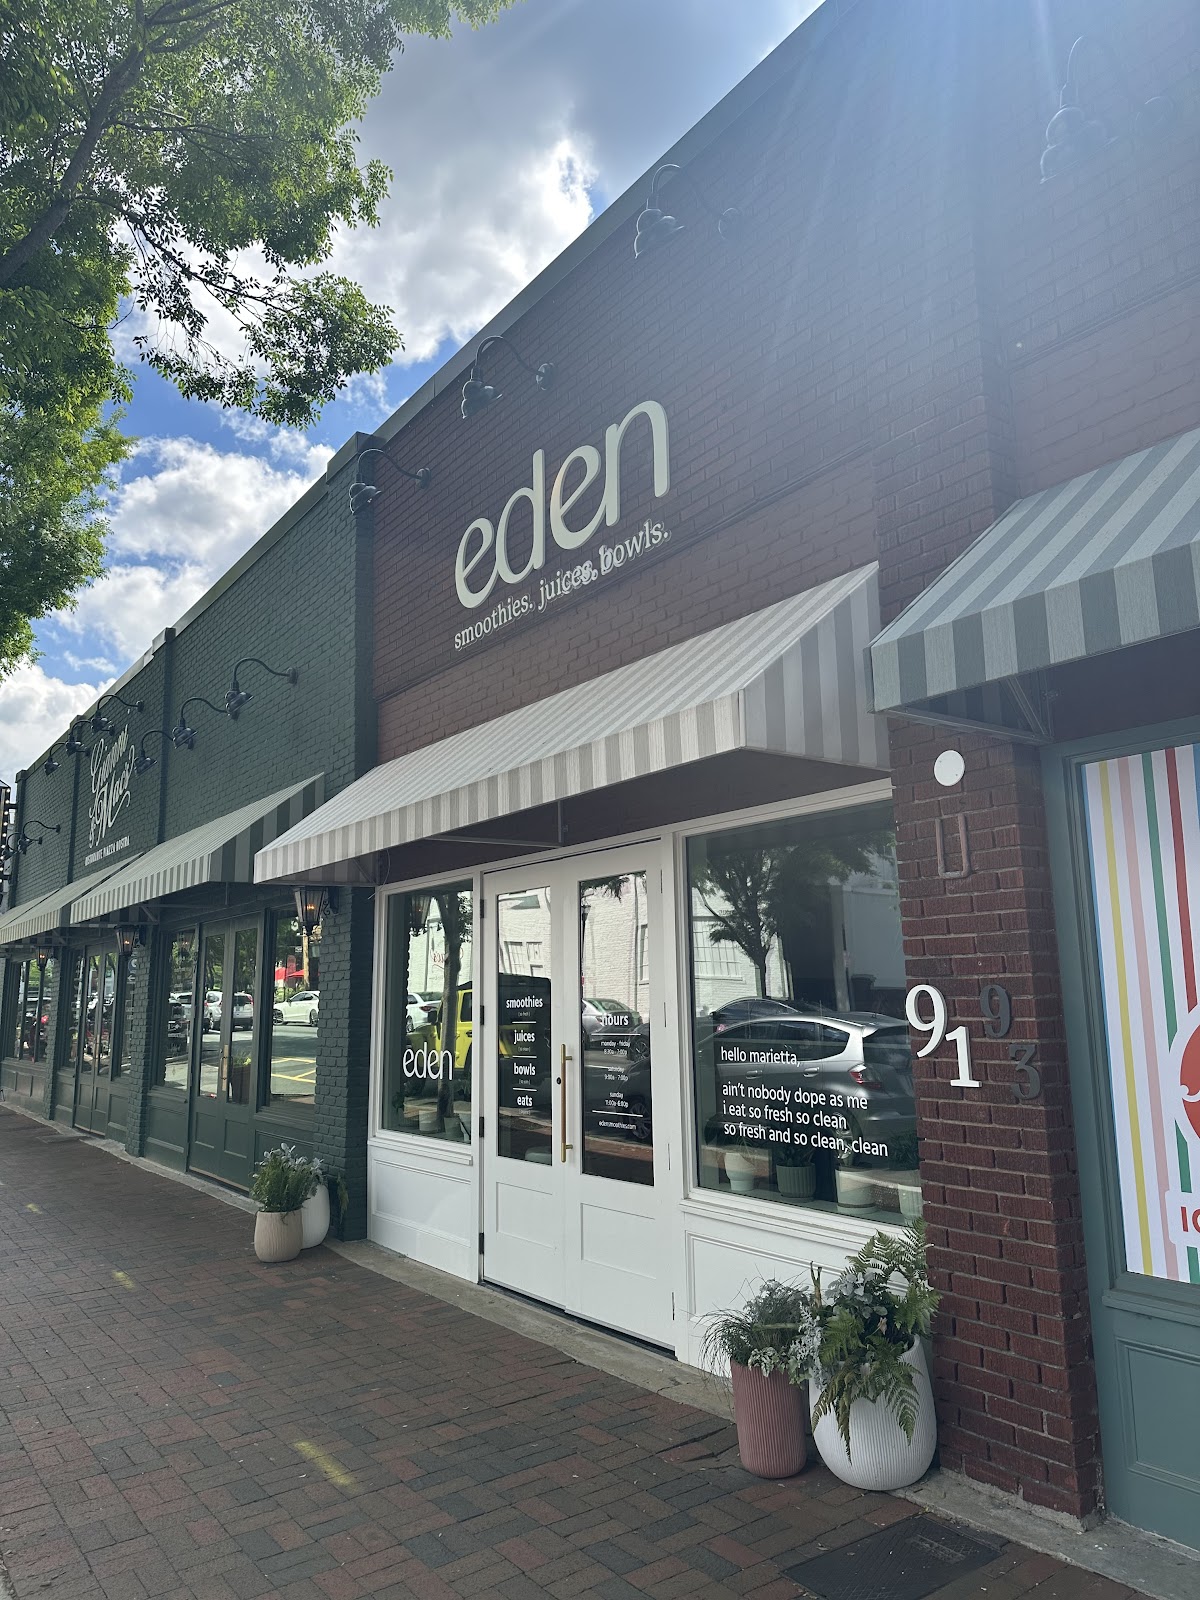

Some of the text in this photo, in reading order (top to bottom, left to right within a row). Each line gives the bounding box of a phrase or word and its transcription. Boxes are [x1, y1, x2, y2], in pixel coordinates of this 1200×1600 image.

[455, 400, 670, 609] eden
[454, 519, 671, 650] smoothies. juices. bowls.
[505, 995, 544, 1008] smoothies
[602, 1013, 629, 1026] hours
[513, 1029, 536, 1045] juices
[905, 984, 982, 1088] 91
[402, 1042, 453, 1081] eden
[721, 1046, 801, 1067] hello marietta,
[513, 1063, 536, 1076] bowls
[517, 1095, 533, 1107] eats
[609, 1091, 624, 1100] sunday
[722, 1081, 868, 1110] ain't nobody dope as me
[723, 1100, 847, 1130] i eat so fresh so clean
[724, 1121, 889, 1158] so fresh and so clean, clean
